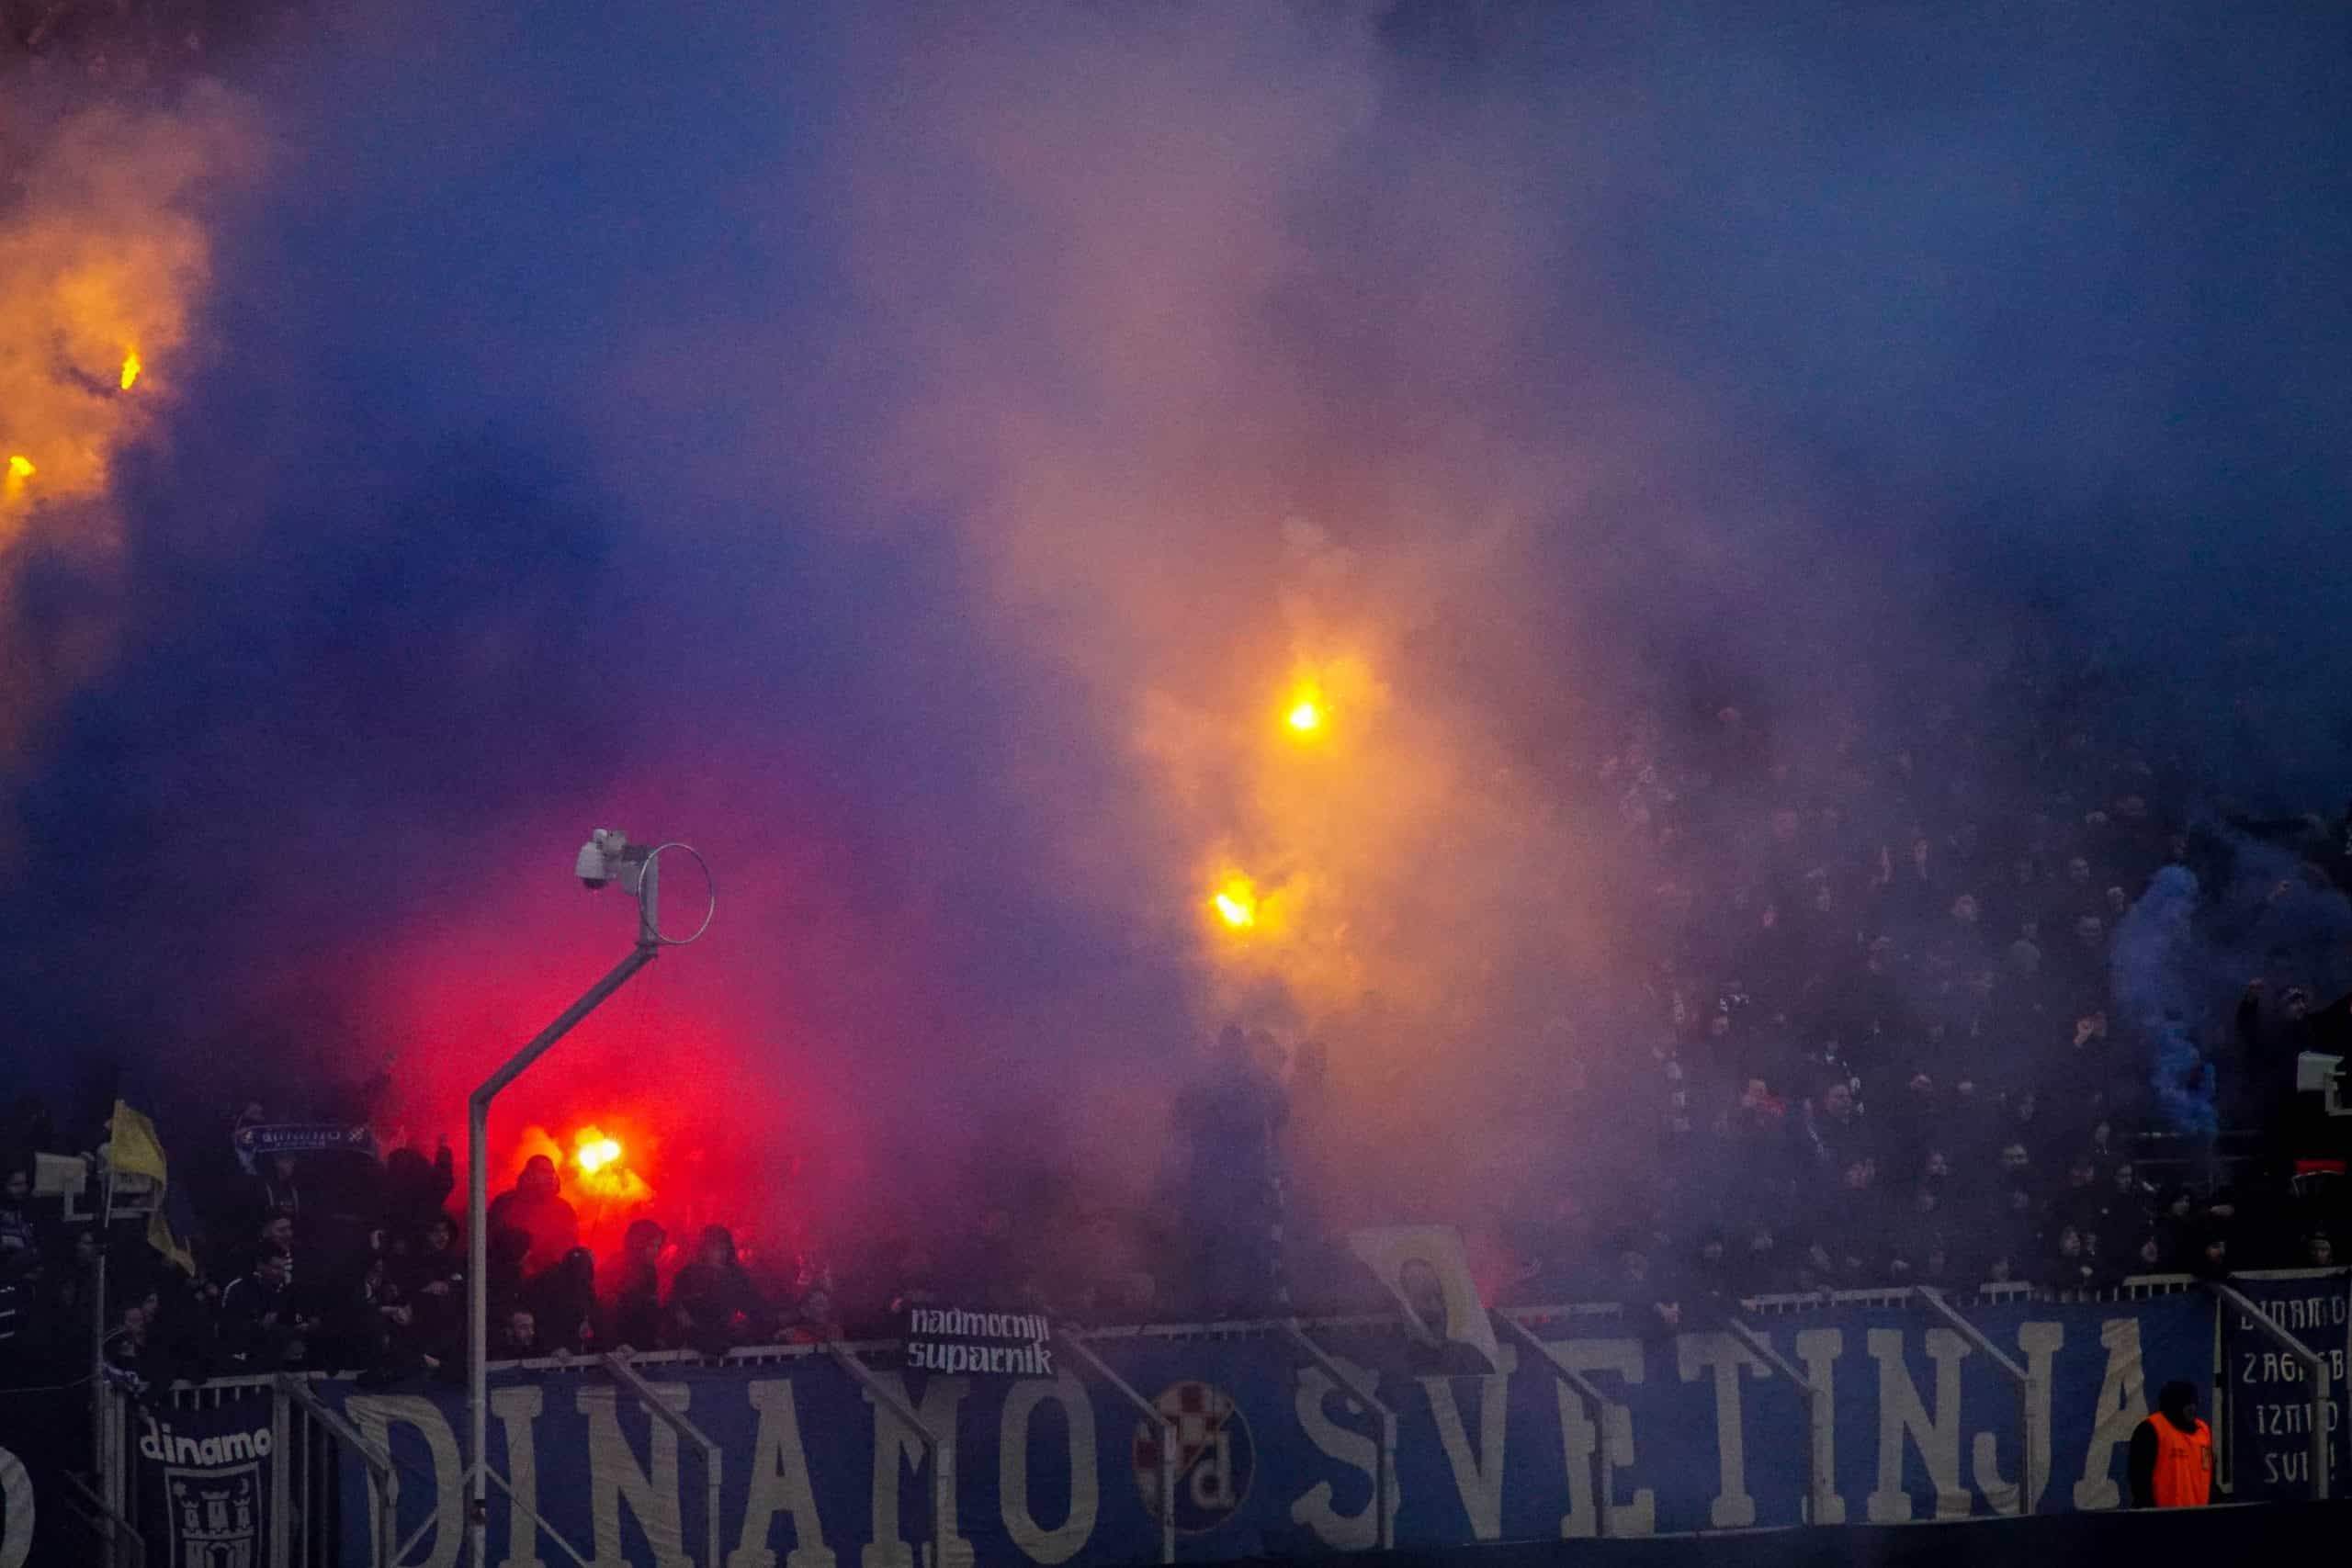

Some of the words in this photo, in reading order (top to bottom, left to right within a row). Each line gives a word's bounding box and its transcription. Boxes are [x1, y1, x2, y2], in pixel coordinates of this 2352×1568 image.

[908, 1341, 1052, 1375] suparnik
[140, 1416, 272, 1465] dinamo
[345, 1377, 1100, 1568] DINAMO
[1291, 1317, 2152, 1551] SVETINJA
